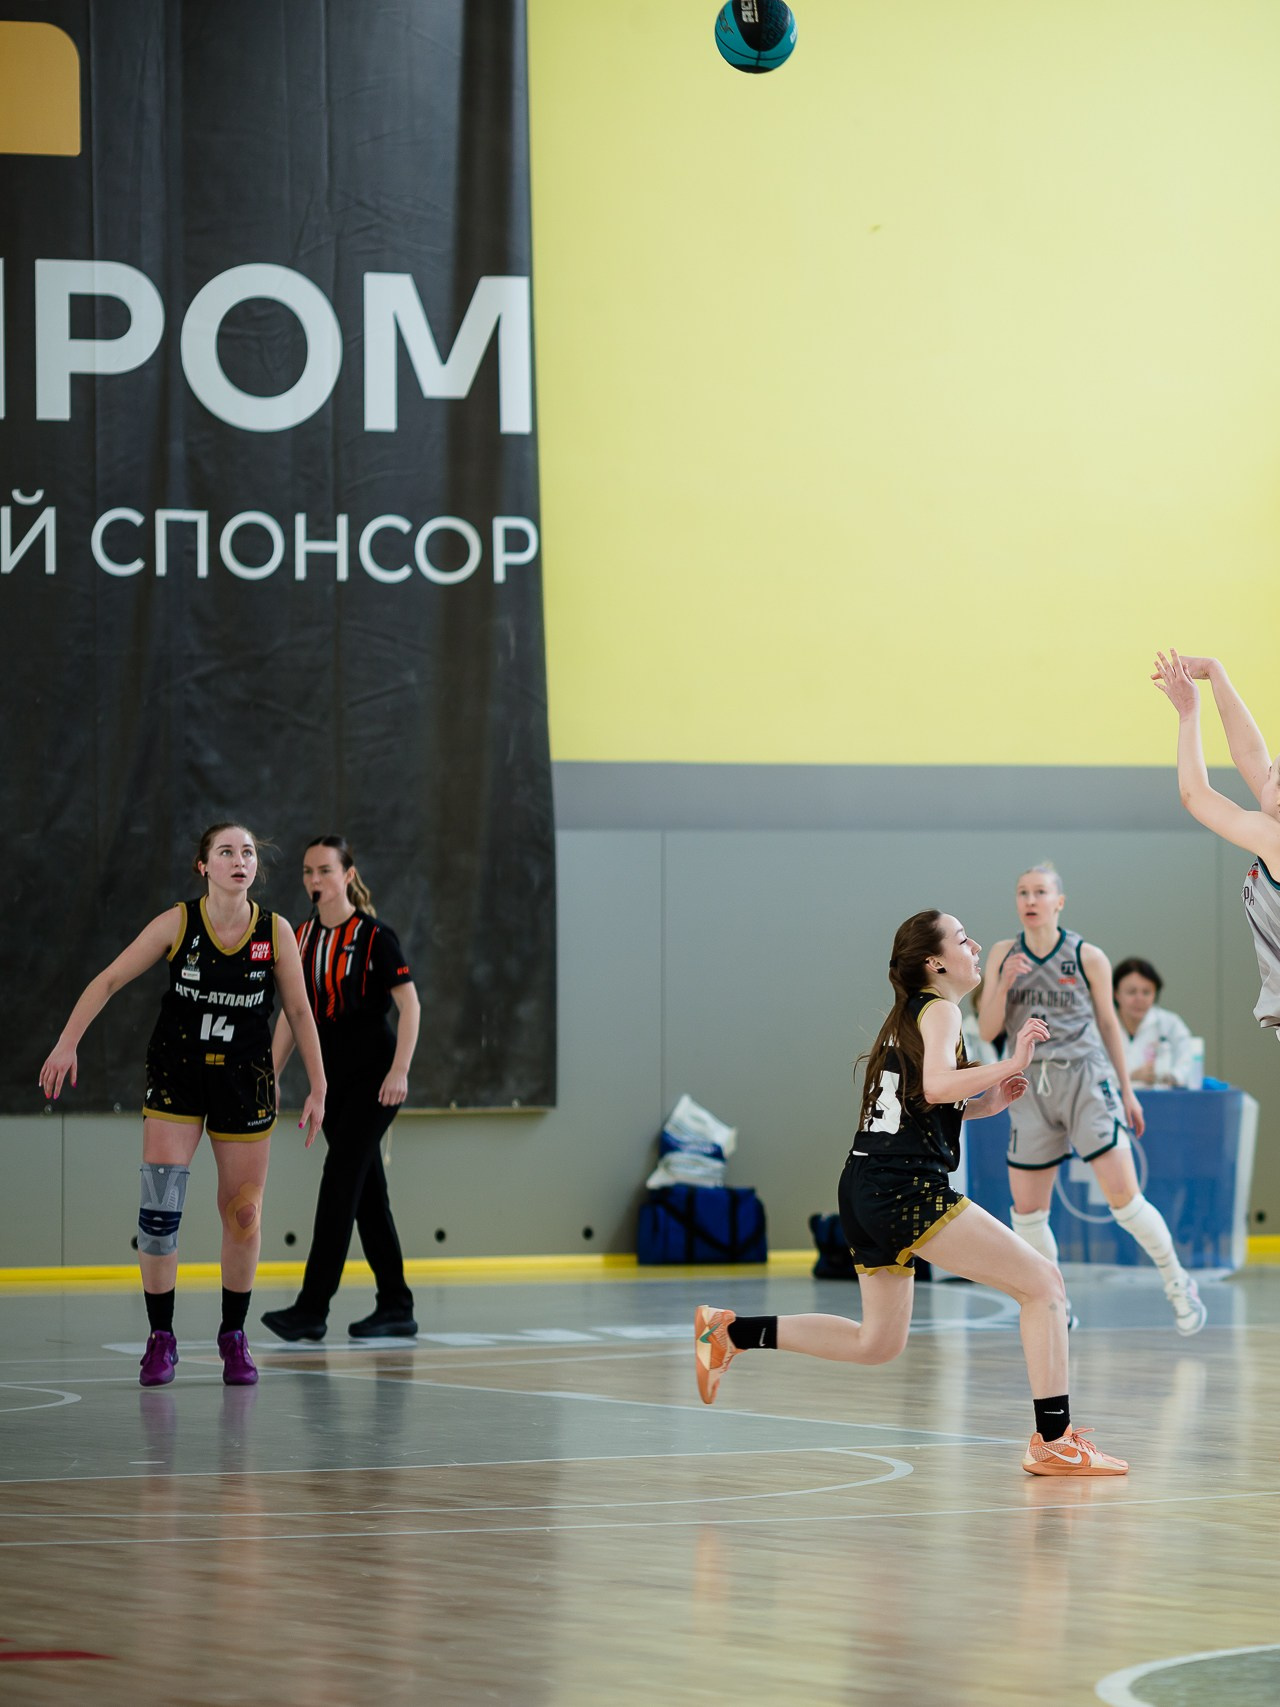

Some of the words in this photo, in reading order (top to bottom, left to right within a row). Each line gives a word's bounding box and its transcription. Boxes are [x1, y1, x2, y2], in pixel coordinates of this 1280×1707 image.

[0, 258, 533, 434] РОМ
[91, 507, 539, 585] СПОНСОР
[251, 942, 270, 952] FON
[251, 951, 269, 960] BET
[200, 1013, 235, 1042] 14
